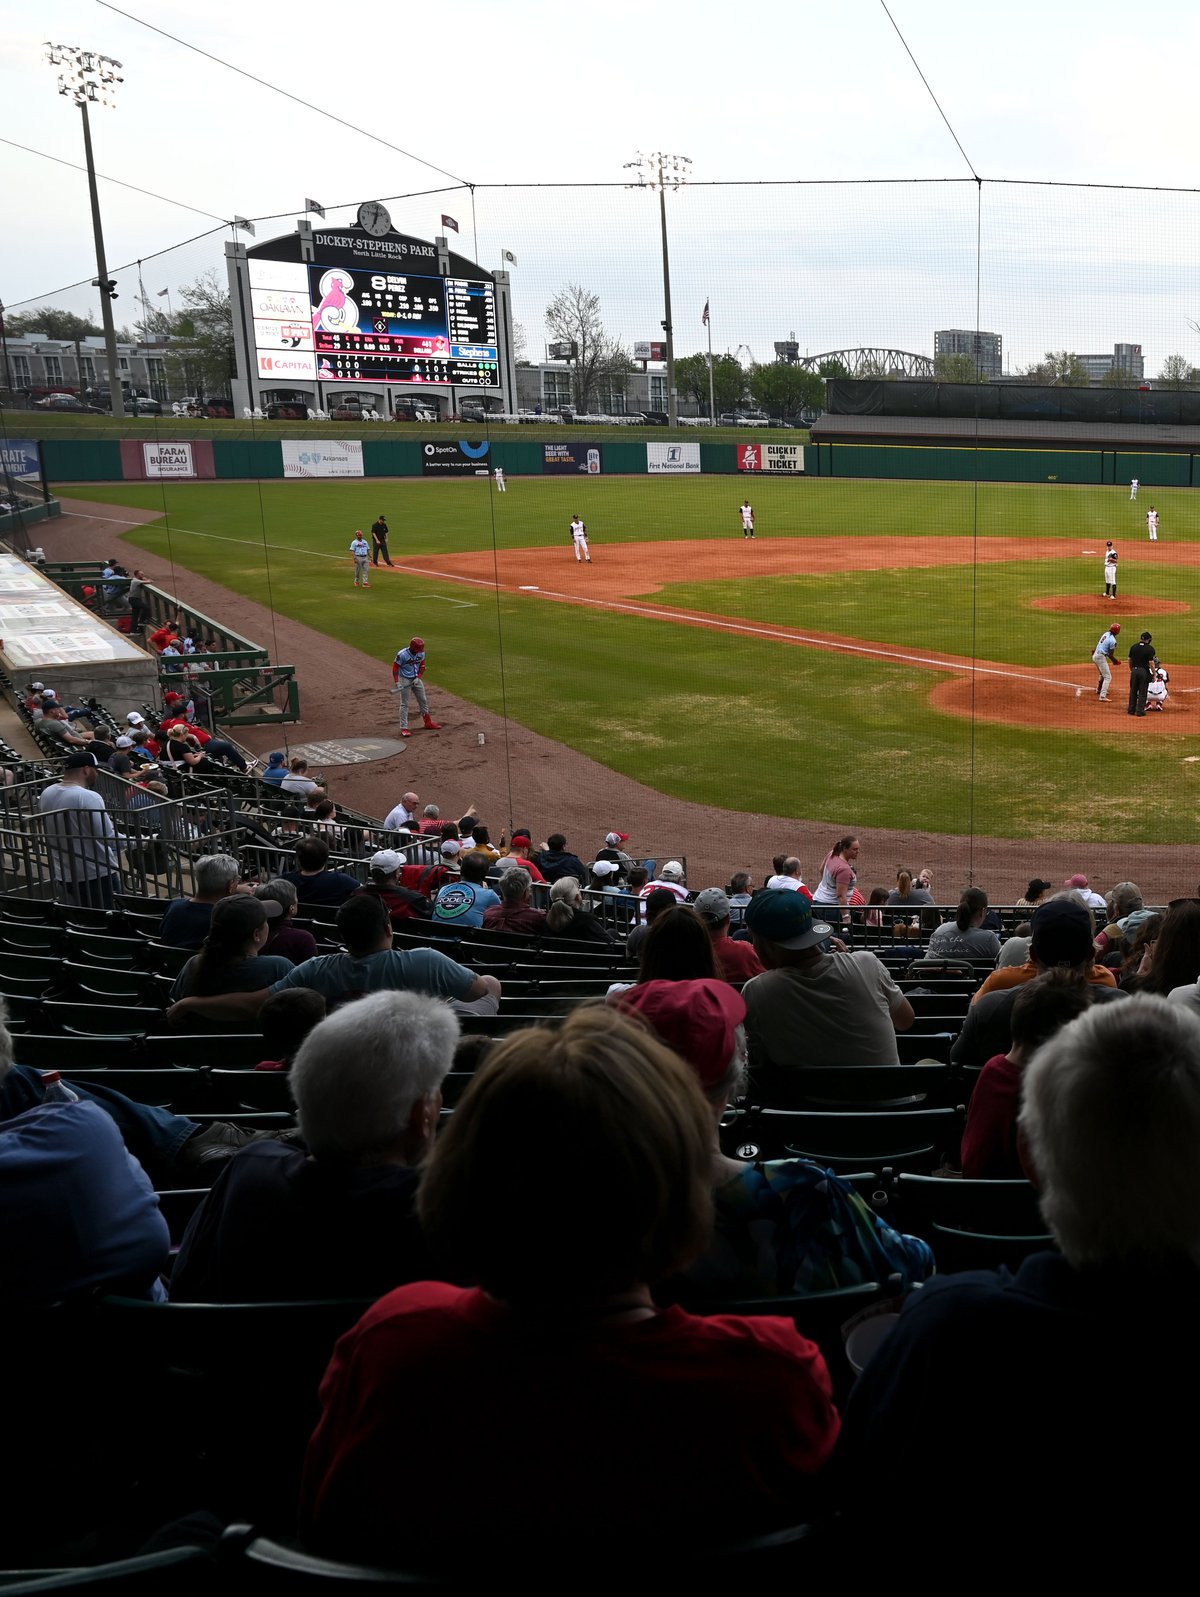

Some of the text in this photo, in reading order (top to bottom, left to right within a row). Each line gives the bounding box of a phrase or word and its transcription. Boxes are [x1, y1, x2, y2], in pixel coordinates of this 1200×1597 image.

[315, 234, 435, 257] DICKEY-STEPHENS PARK
[371, 275, 387, 290] 8
[387, 284, 406, 293] PEREZ
[259, 302, 304, 314] OAKLAWN
[458, 347, 490, 358] Stephens
[274, 360, 313, 370] CAPITAL
[160, 447, 186, 455] FARM
[669, 448, 677, 460] 1
[767, 446, 797, 455] CLICK IT
[0, 450, 27, 462] RATE
[150, 456, 187, 464] BUREAU
[768, 459, 797, 469] TICKET
[949, 935, 964, 943] the
